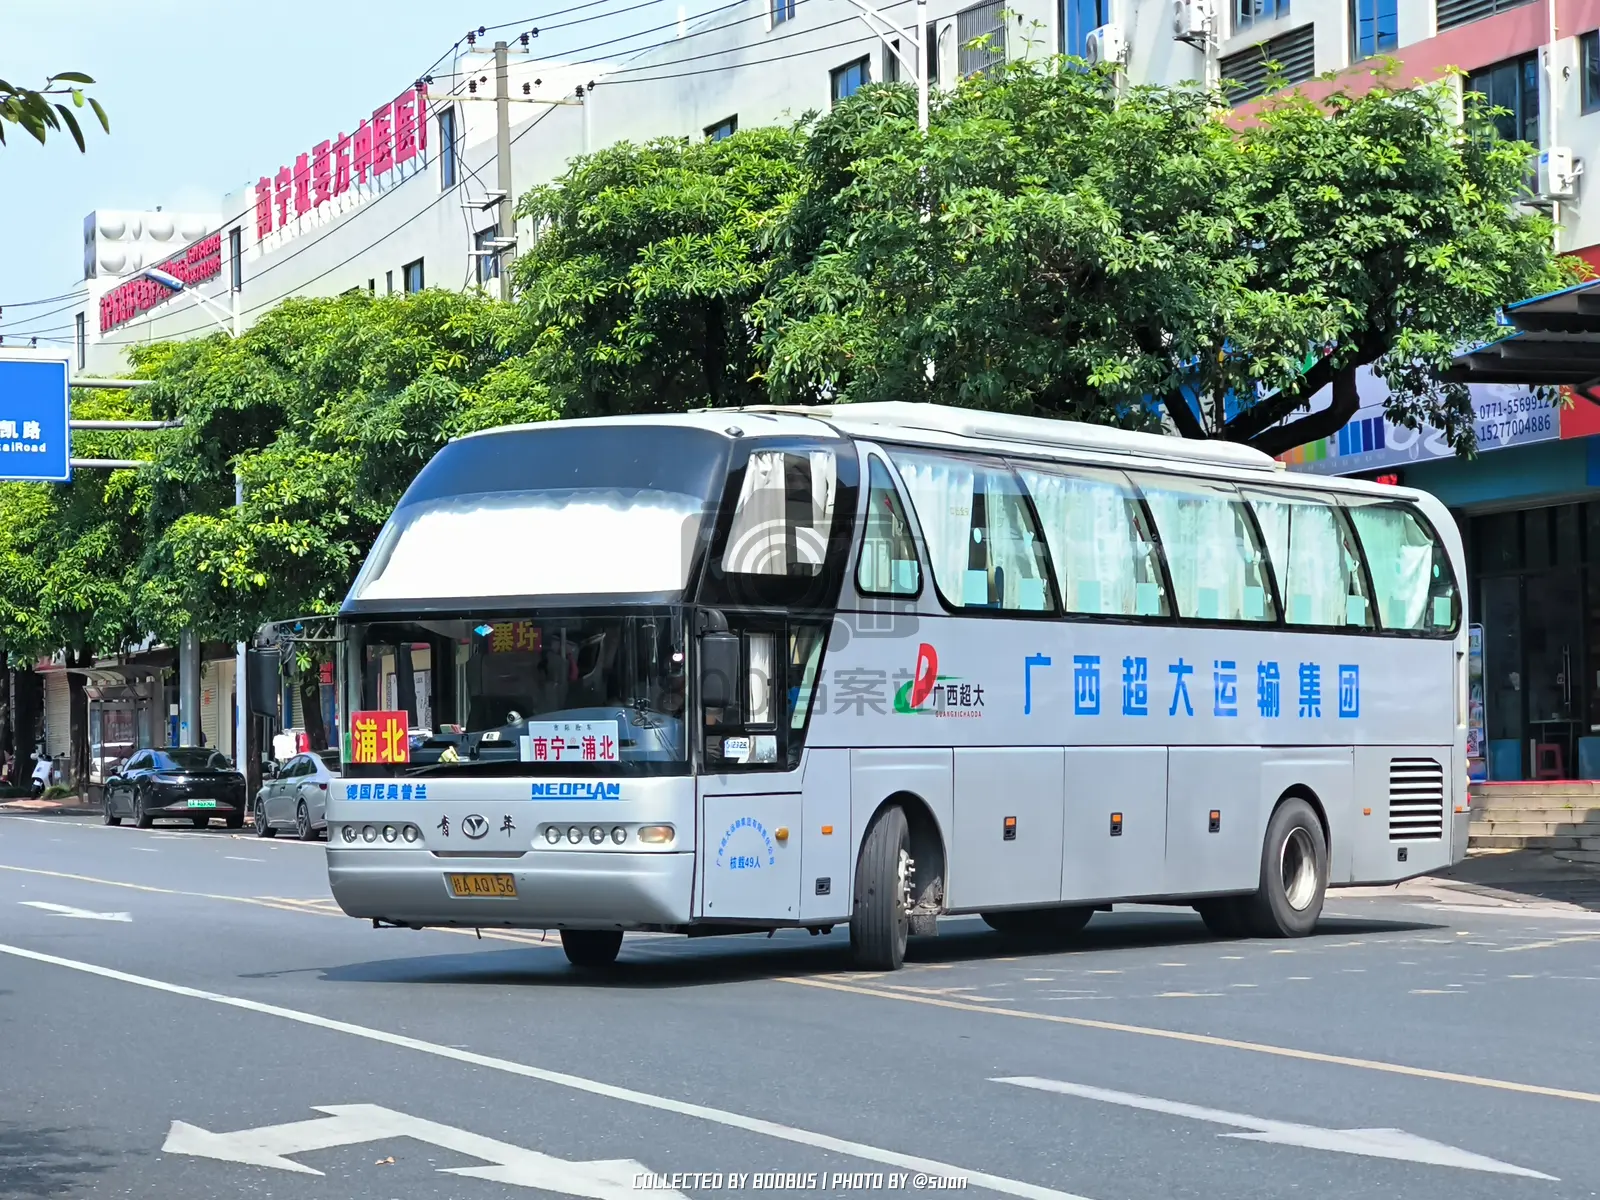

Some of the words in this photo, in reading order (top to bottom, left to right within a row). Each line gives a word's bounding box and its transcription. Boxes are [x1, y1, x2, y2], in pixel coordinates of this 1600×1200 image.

[1480, 393, 1550, 419] 0771-5569912
[1480, 414, 1551, 442] 15277004886
[932, 683, 984, 707] 广西超大
[1024, 652, 1360, 718] 广西超大运输集团
[354, 718, 406, 763] 浦北
[346, 784, 427, 800] 德国尼奥普兰
[532, 781, 620, 800] NEOPLAN
